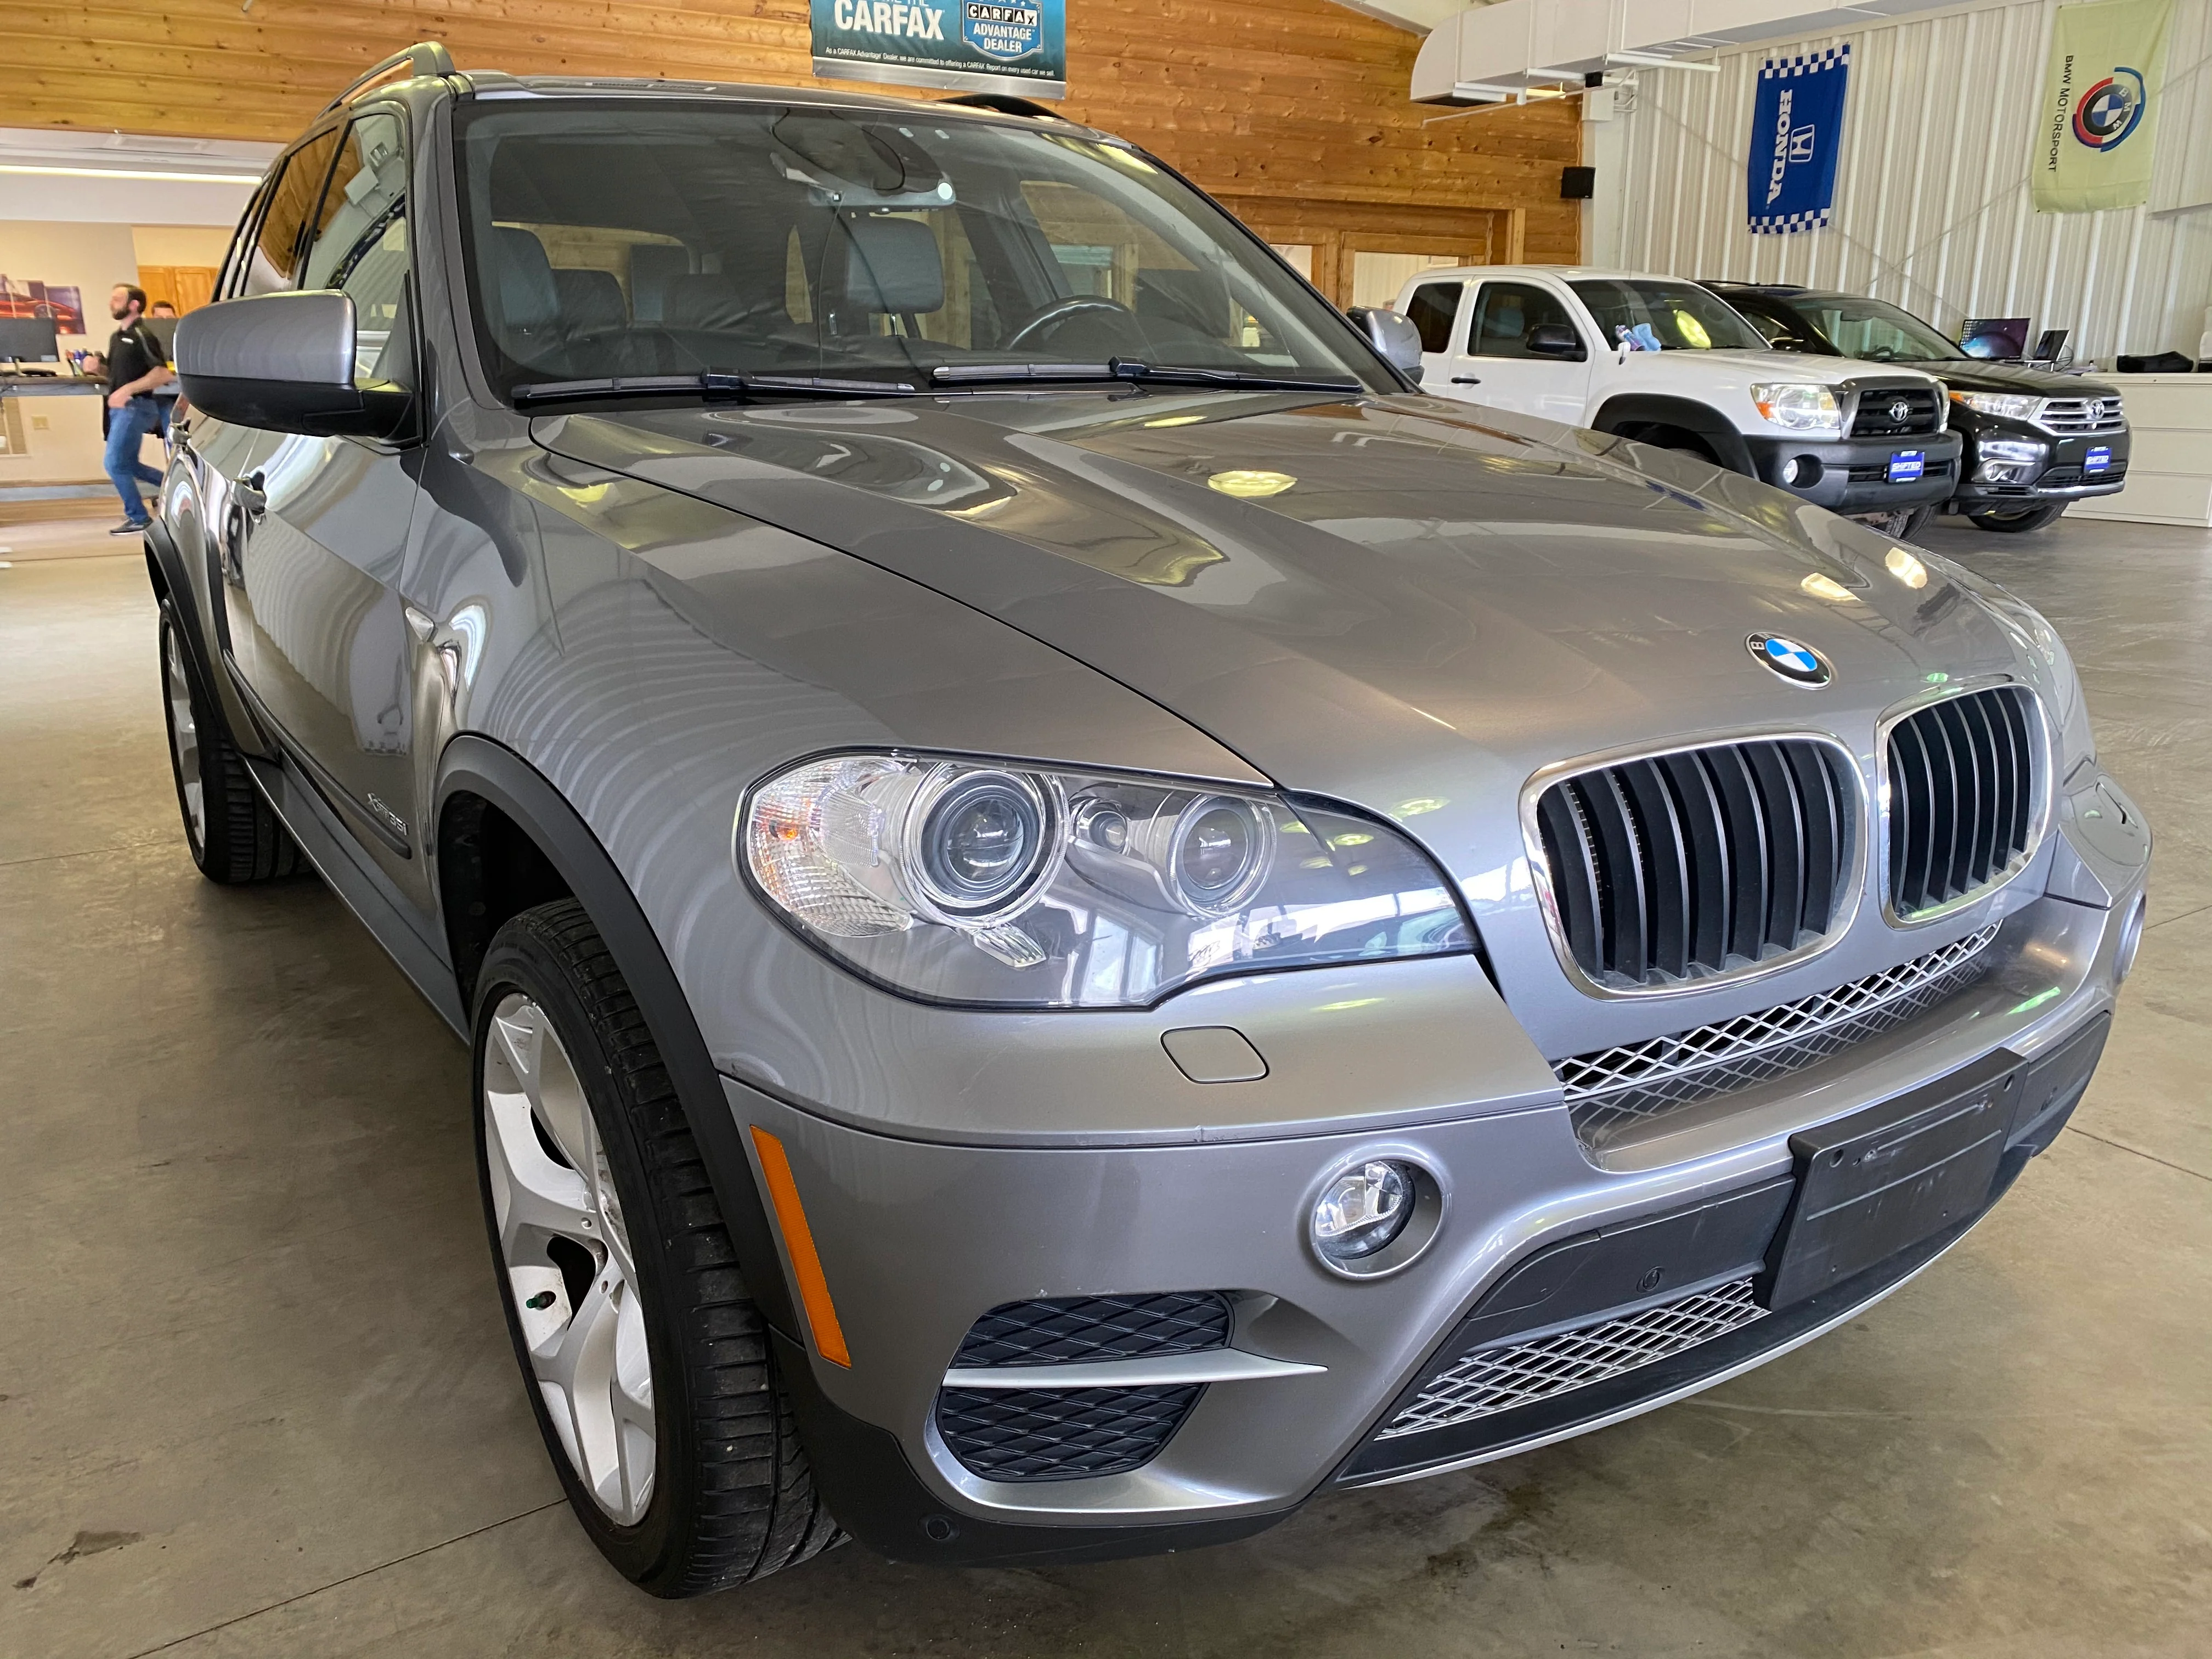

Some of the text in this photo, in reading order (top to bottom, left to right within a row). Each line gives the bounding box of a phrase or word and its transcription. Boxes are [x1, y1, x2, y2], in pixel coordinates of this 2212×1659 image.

[834, 0, 945, 40] CARFAX
[969, 5, 1035, 25] CARFAX
[973, 22, 1032, 40] ADVANTAGE
[984, 38, 1022, 53] DEALER
[945, 60, 962, 69] offering
[2048, 55, 2074, 172] BMW MOTORSPORT
[1767, 89, 1793, 204] HONDA
